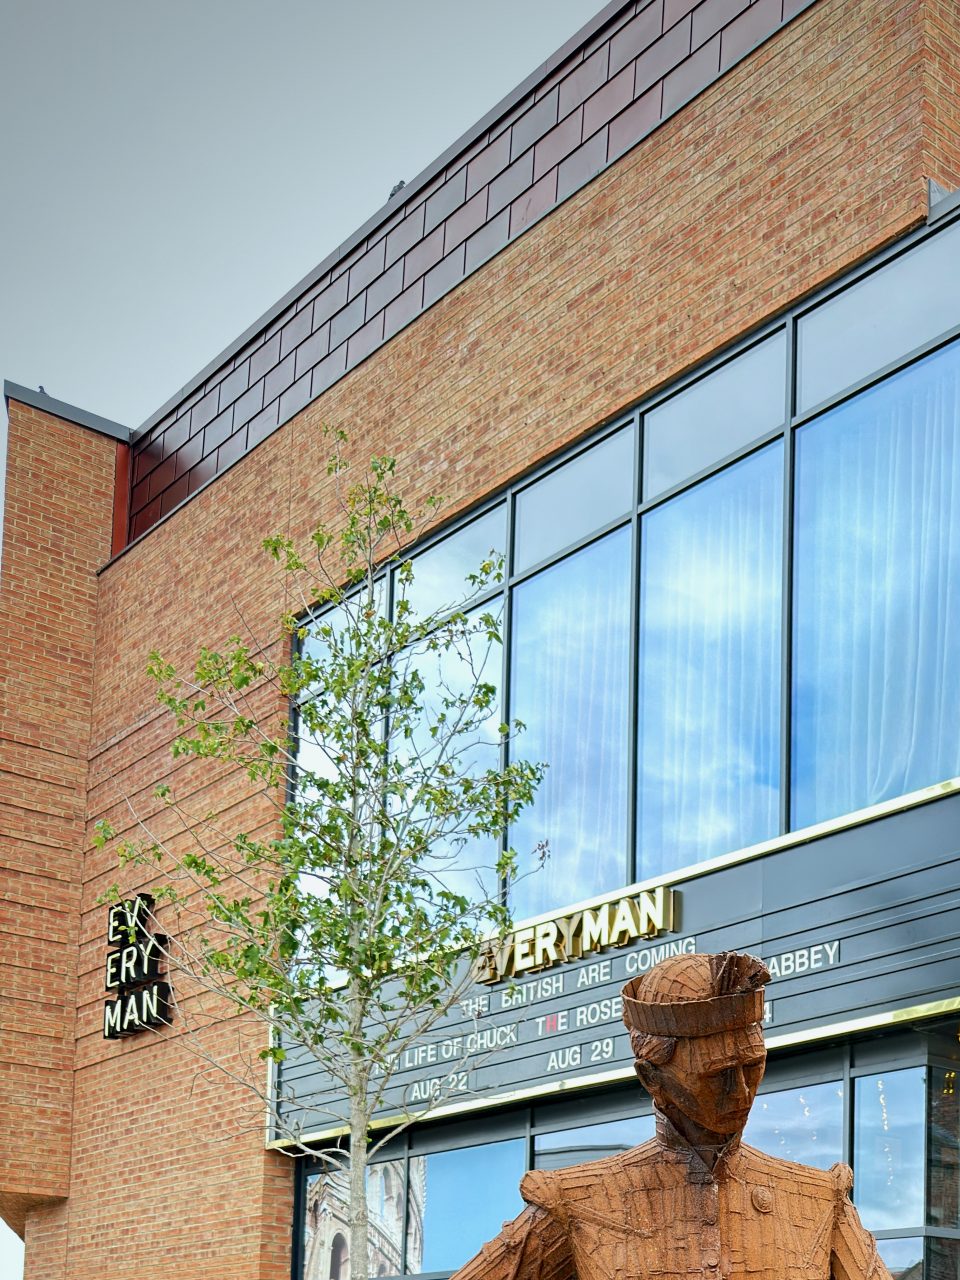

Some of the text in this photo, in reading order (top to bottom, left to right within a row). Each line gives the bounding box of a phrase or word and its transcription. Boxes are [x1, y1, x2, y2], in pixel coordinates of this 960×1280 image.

[108, 895, 148, 944] EV
[106, 937, 160, 988] ERY
[768, 940, 839, 977] ABBEY
[501, 974, 564, 1008] BRITISH
[577, 960, 611, 988] ARE
[104, 984, 163, 1037] MAN
[535, 1010, 568, 1036] THE
[404, 1043, 437, 1068] LIFE
[442, 1037, 463, 1059] OF
[466, 1023, 517, 1053] CHUCK
[546, 1038, 613, 1071] AUG 29
[411, 1072, 468, 1101] AUG 22
